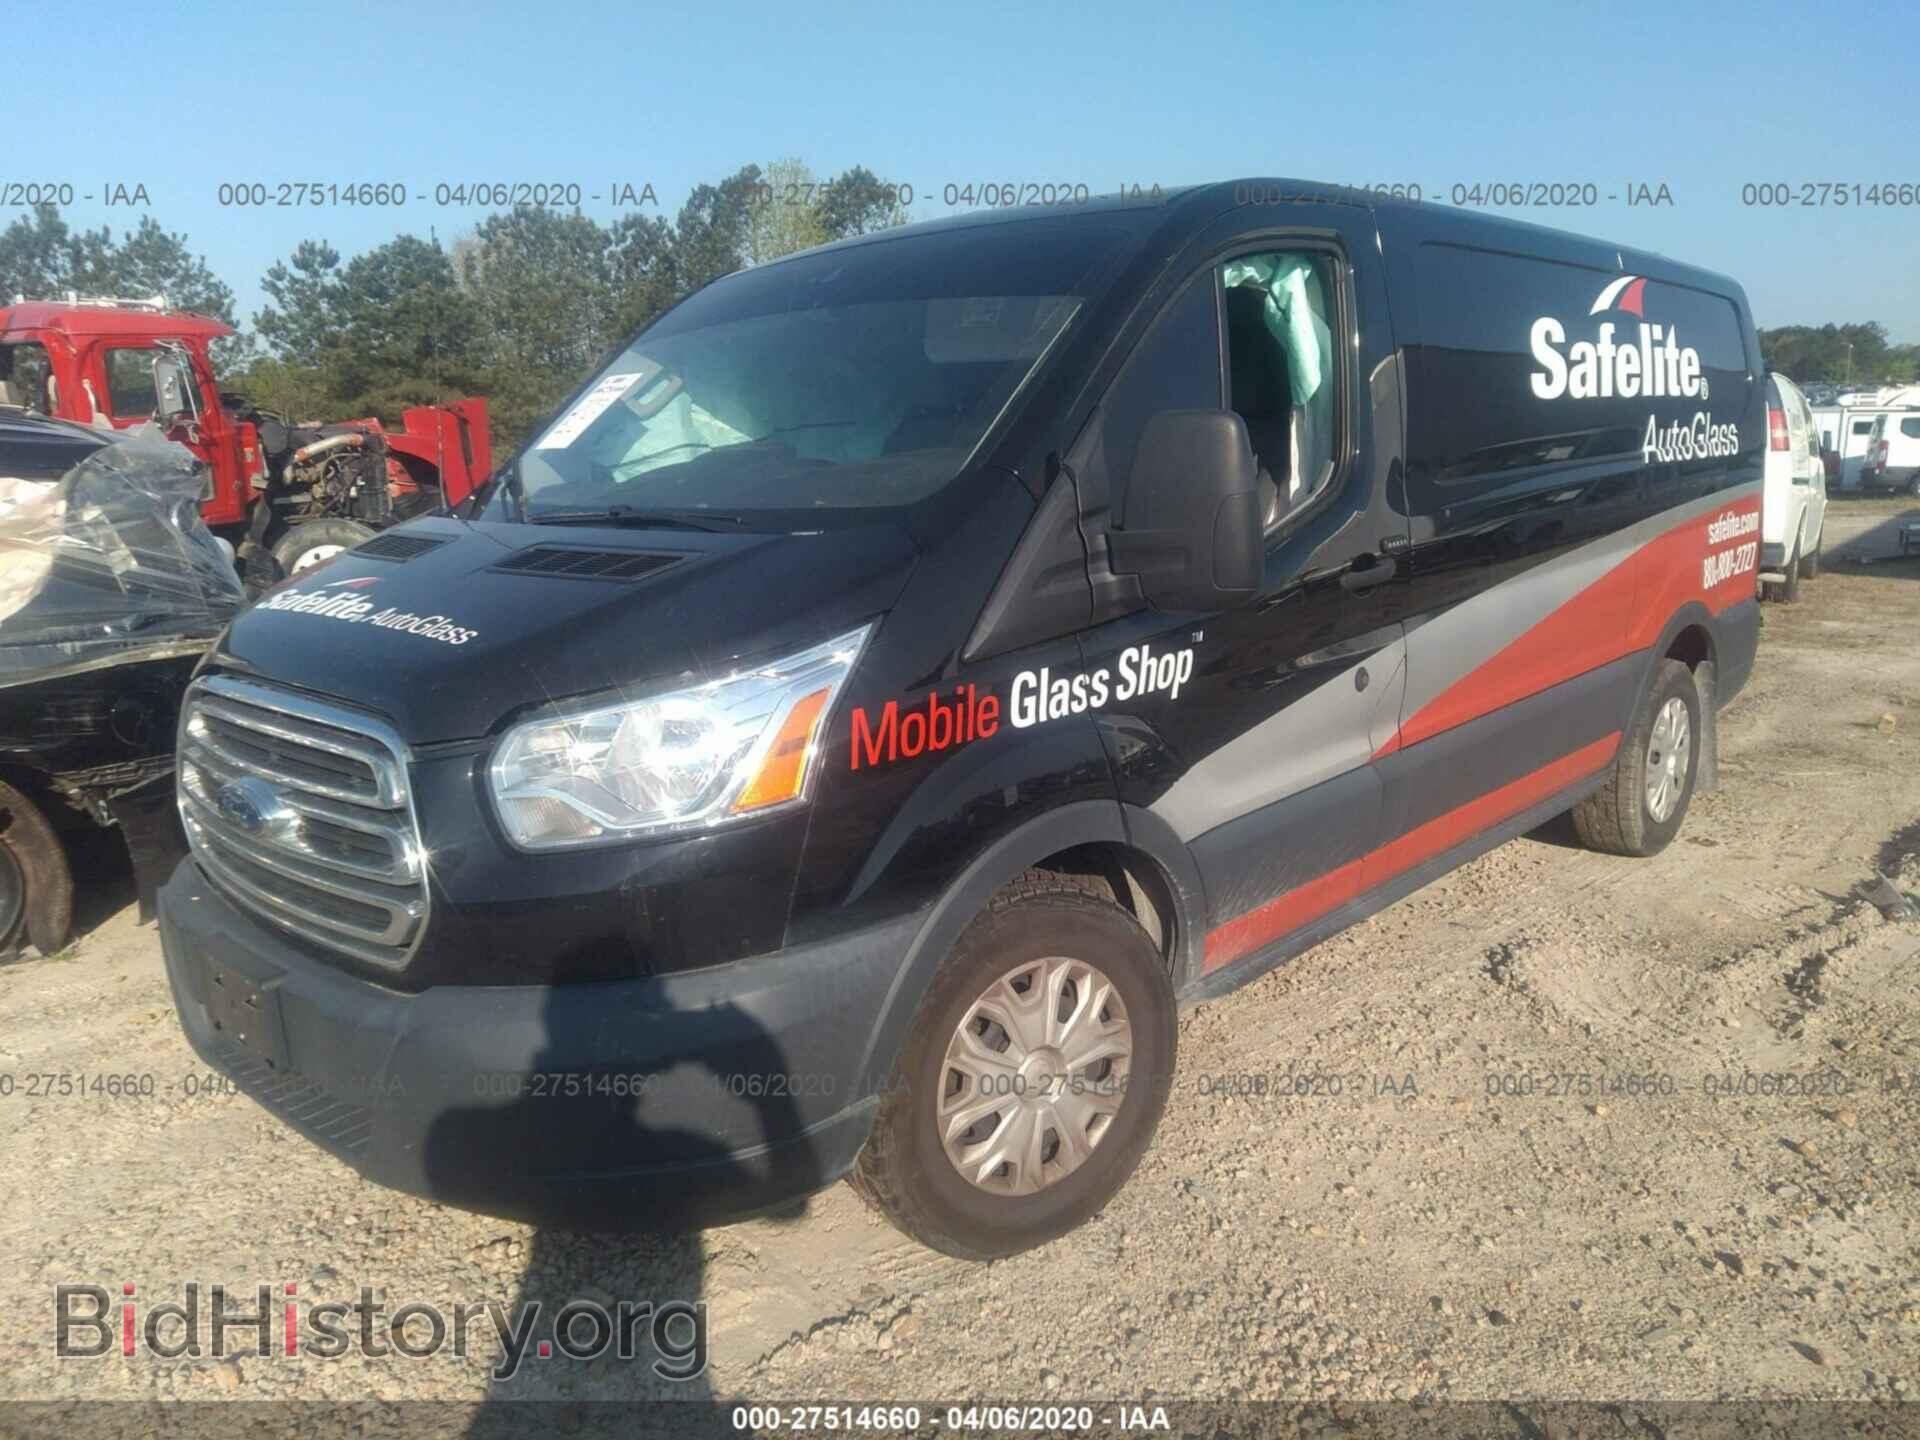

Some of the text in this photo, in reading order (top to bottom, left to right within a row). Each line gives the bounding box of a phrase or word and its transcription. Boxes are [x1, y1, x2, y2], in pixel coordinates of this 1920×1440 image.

[1530, 316, 1701, 400] Safelite
[1642, 411, 1739, 464] AutoGlass
[361, 606, 478, 645] AutoGlass
[850, 643, 1194, 770] Mobile Glass Shop
